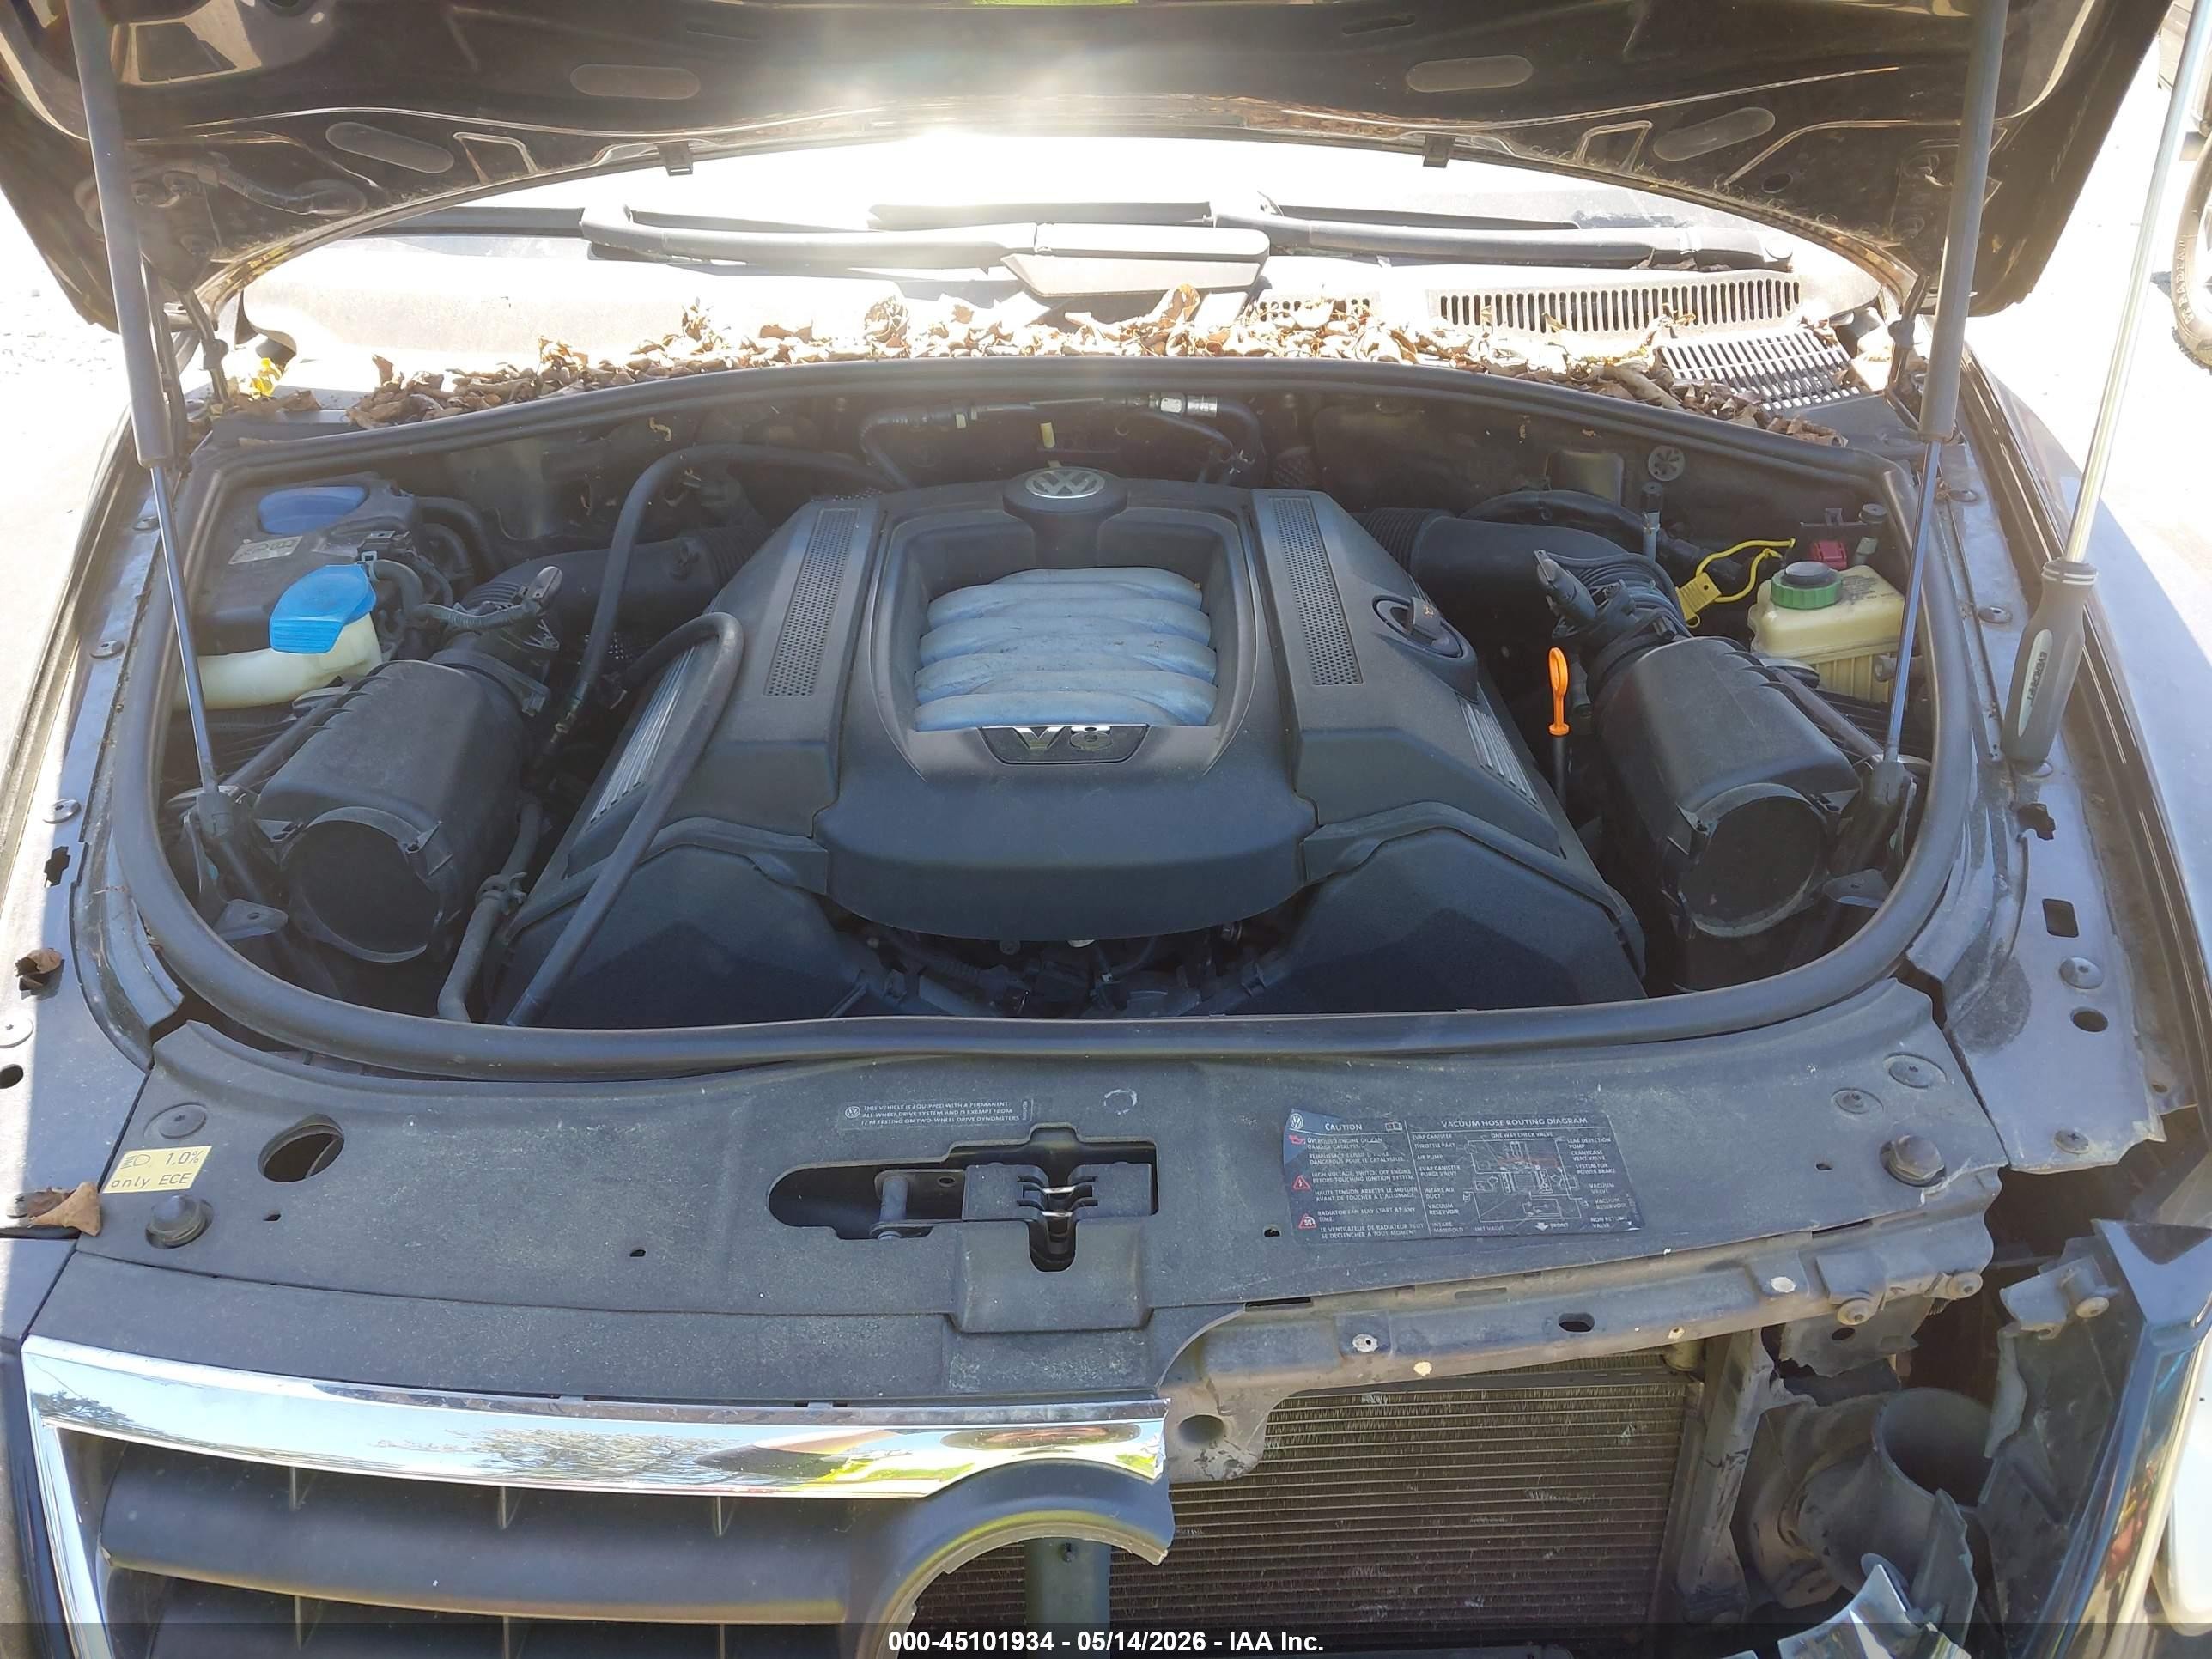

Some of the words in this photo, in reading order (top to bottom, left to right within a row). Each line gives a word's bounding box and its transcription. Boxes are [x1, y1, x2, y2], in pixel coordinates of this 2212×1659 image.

[1012, 726, 1115, 753] V8
[1441, 1120, 1480, 1128] VACUUM
[165, 1149, 204, 1166] 1.0%
[110, 1176, 151, 1189] only
[158, 1172, 192, 1186] ECE
